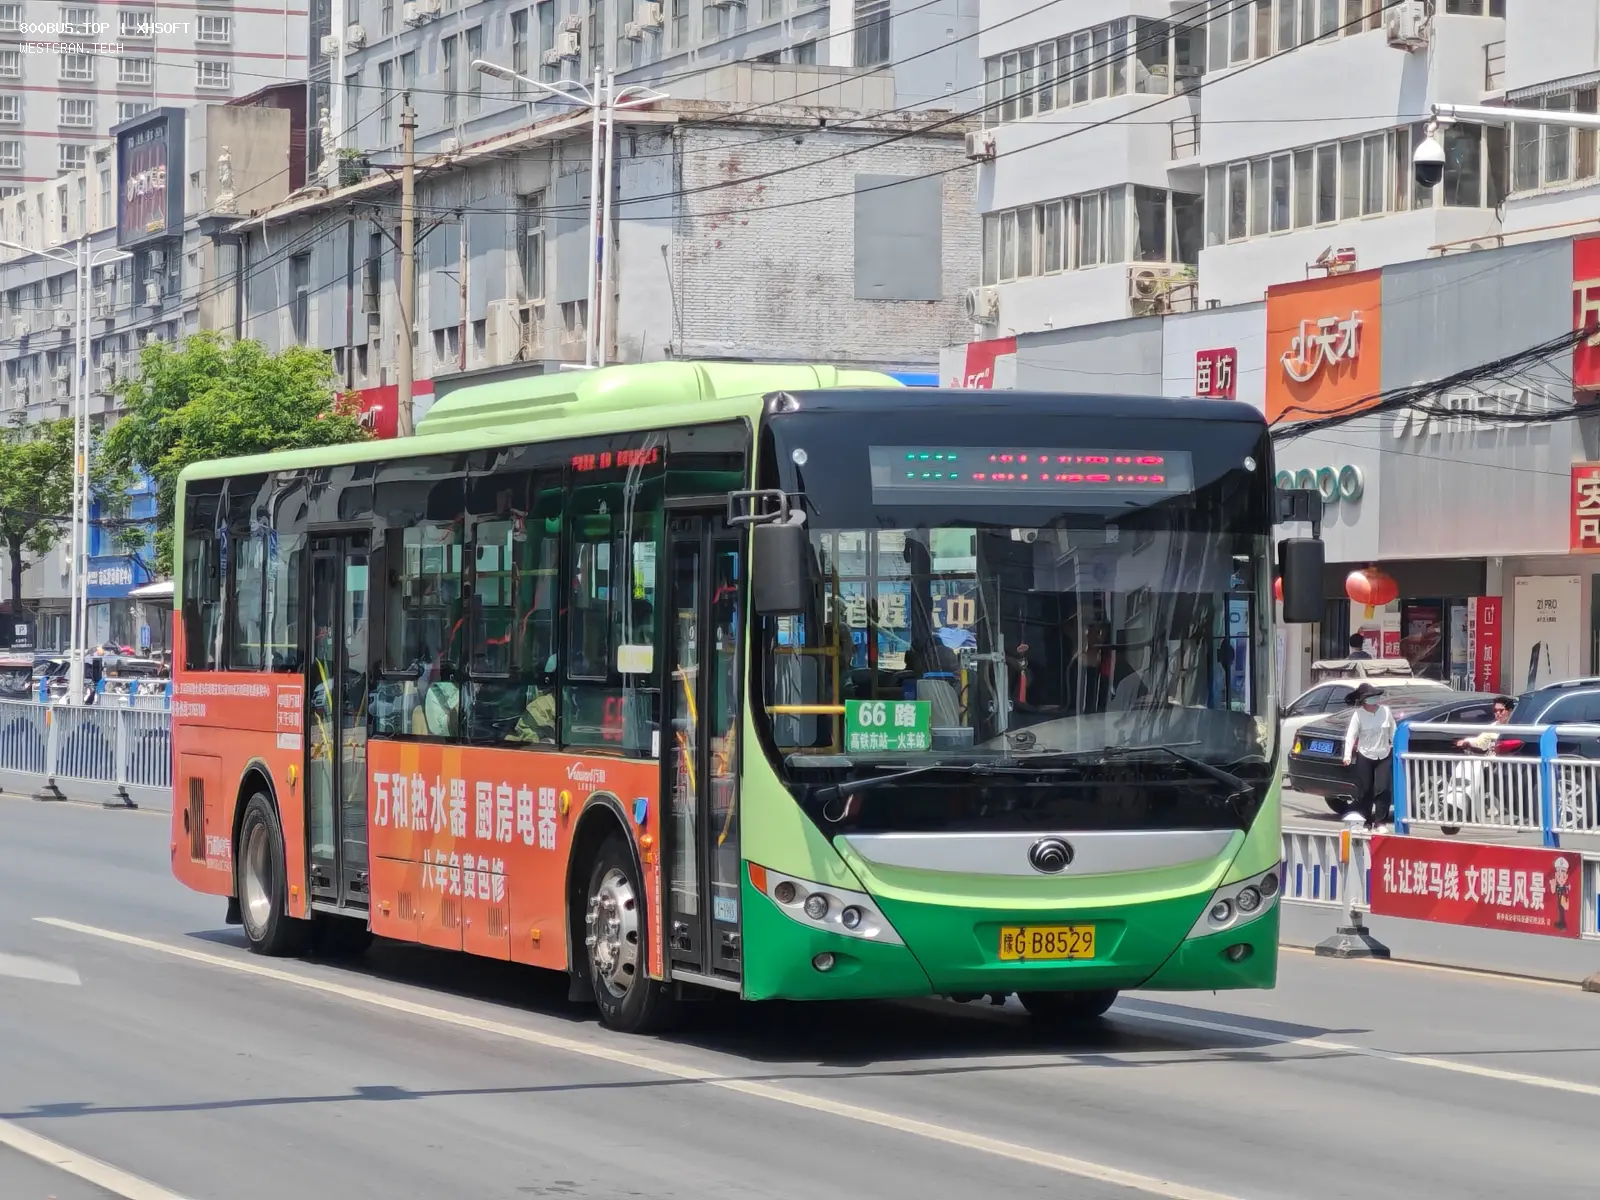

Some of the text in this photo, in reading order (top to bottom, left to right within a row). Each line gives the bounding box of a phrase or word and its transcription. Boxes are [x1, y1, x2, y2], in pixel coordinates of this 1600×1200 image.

[1280, 310, 1362, 382] 小天才
[1197, 355, 1233, 393] 苗坊
[859, 703, 916, 727] 66 路
[374, 772, 557, 850] 万和热水器 厨房电器
[422, 848, 505, 903] 八年免费包修
[1383, 857, 1546, 910] 礼让斑马线 文明是风景
